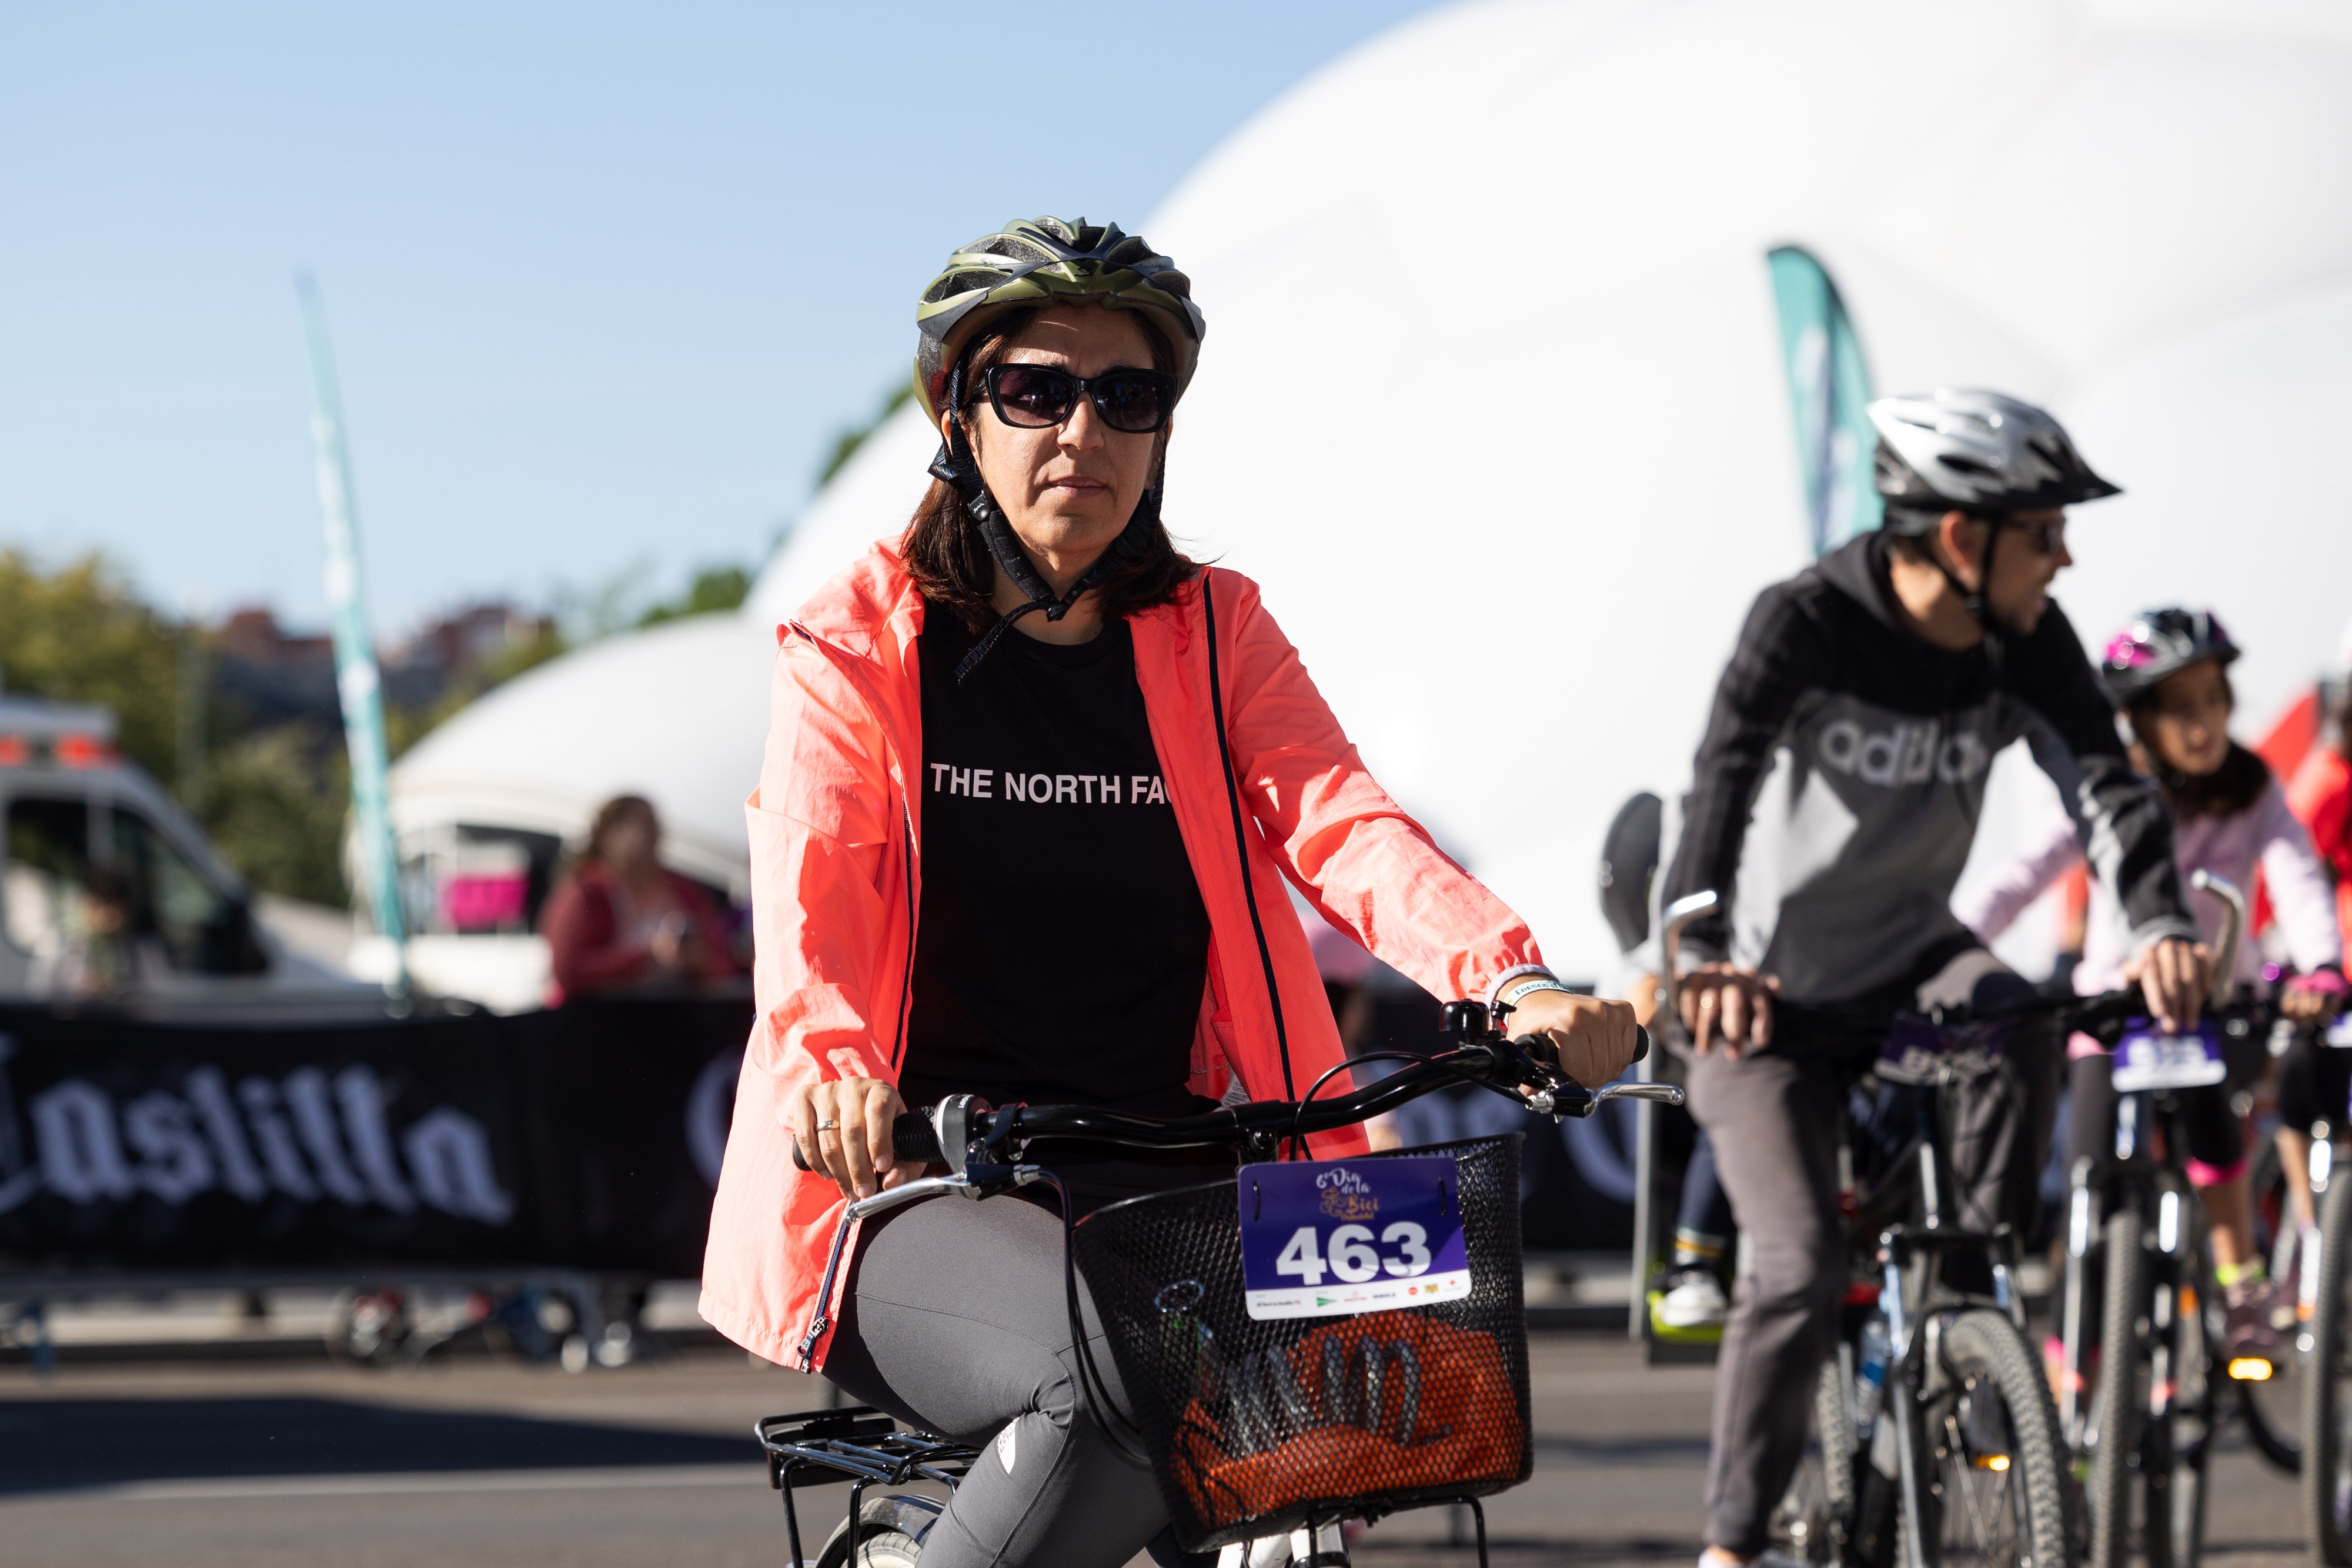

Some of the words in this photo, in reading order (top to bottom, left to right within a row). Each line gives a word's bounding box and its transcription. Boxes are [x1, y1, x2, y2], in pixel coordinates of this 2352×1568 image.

[930, 763, 993, 798] THE
[1005, 772, 1121, 804] NORTH
[1345, 1193, 1379, 1213] Bici
[1276, 1221, 1432, 1286] 463
